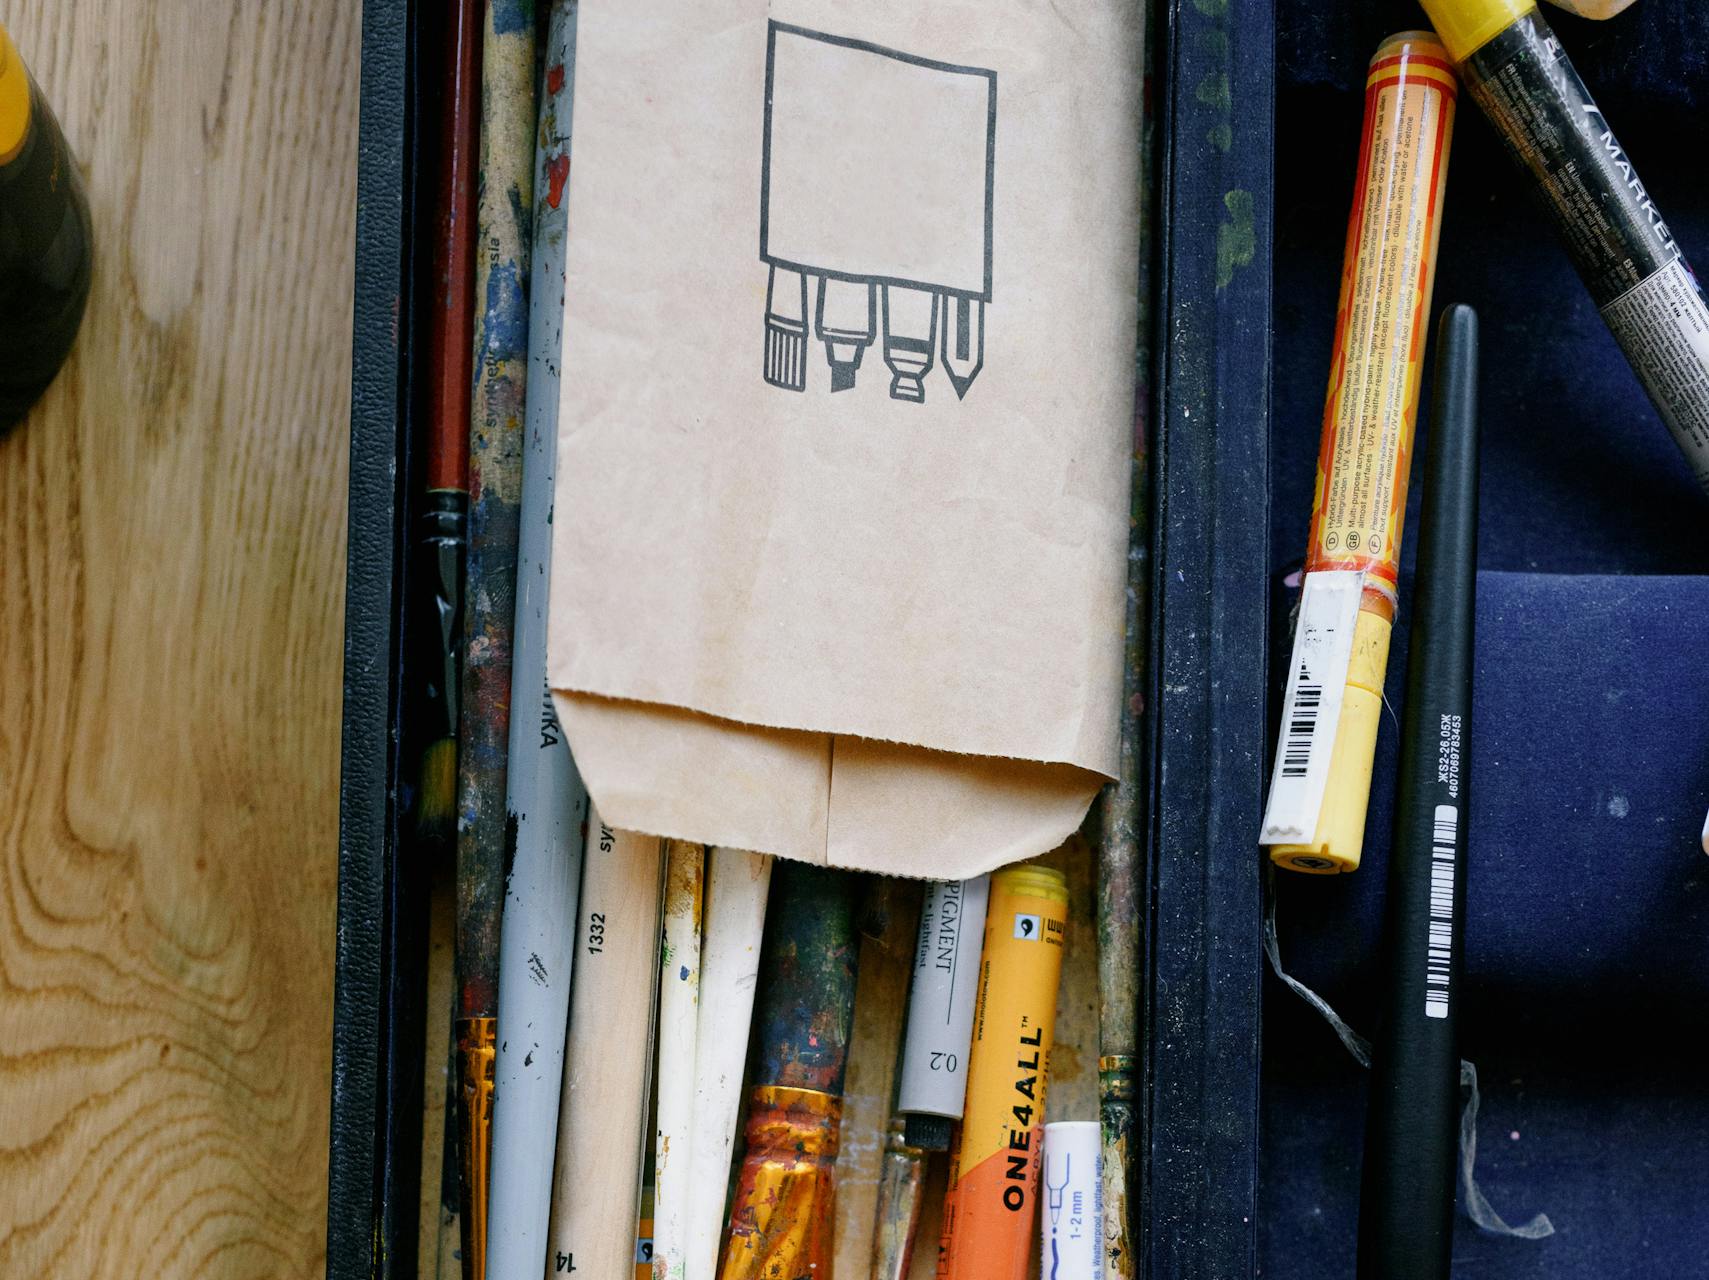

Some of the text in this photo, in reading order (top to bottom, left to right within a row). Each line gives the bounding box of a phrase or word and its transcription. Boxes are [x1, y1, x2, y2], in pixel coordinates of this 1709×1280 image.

[1403, 115, 1414, 148] acetone
[1402, 149, 1410, 158] or
[1564, 161, 1576, 173] EN
[1399, 160, 1409, 181] water
[1397, 183, 1406, 201] with
[1392, 202, 1403, 237] dilutable
[1388, 244, 1398, 271] colors)
[1382, 273, 1395, 317] fluorescent
[480, 237, 502, 427] syntheti ssia
[1378, 319, 1389, 349] (except
[1362, 363, 1375, 412] hybrid-paint
[1370, 351, 1385, 420] weather-resistant
[1355, 414, 1369, 468] acrylic-based
[1367, 430, 1375, 446] UV-
[1362, 452, 1373, 487] surfaces
[1348, 470, 1362, 527] Multi-purpose
[1360, 489, 1368, 498] all
[1357, 501, 1367, 528] almost
[1349, 534, 1357, 548] GB
[1449, 714, 1461, 798] 4607069783453
[587, 912, 605, 955] 1332
[918, 913, 933, 968] lightfast
[925, 883, 958, 970] PIGMENT
[978, 960, 990, 1040] www.molotow.com
[928, 1050, 958, 1073] 0.2
[1072, 1190, 1082, 1213] mm
[554, 1251, 577, 1273] 14
